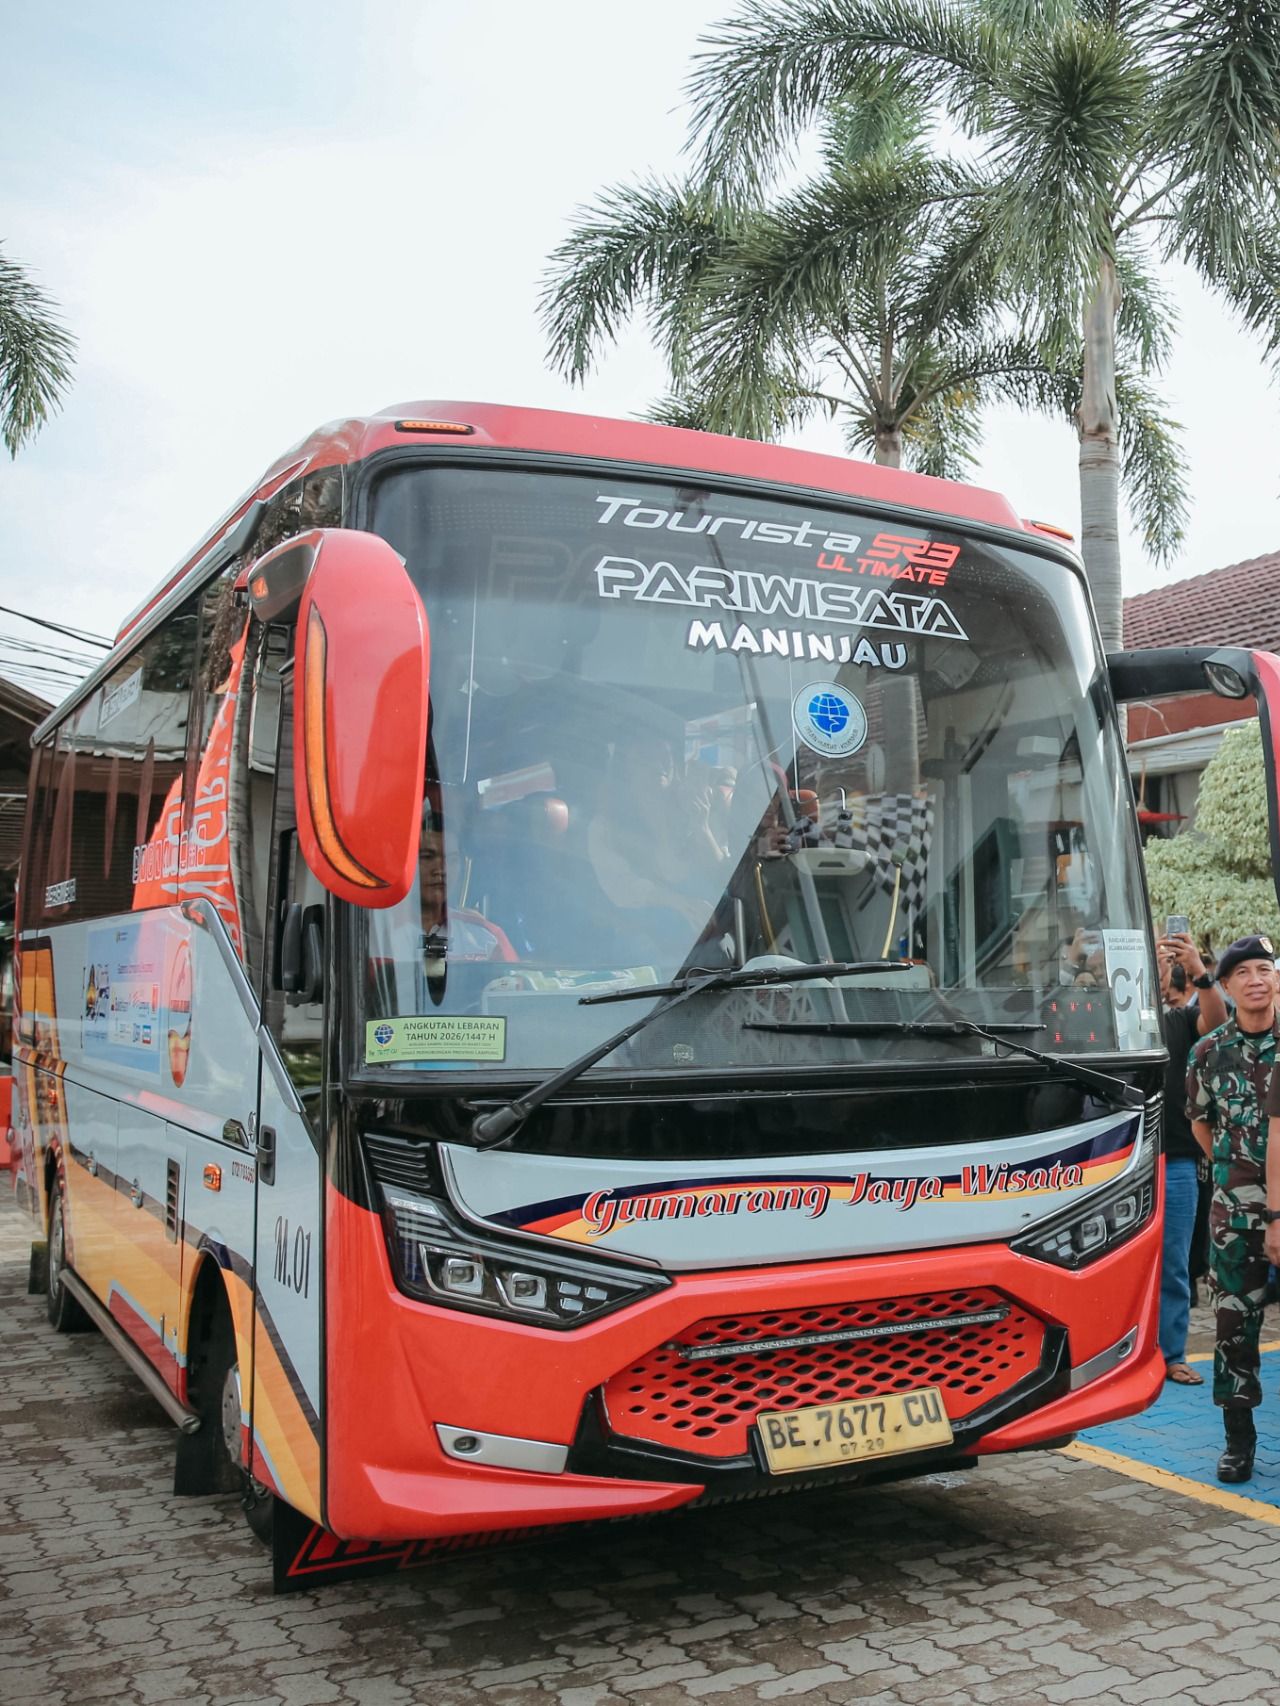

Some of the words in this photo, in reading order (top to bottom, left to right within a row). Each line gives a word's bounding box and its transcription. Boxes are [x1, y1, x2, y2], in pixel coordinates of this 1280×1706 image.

[595, 494, 862, 555] Tourista
[816, 550, 949, 587] ULTIMATE
[593, 554, 970, 641] PARIWISATA
[685, 618, 909, 670] MANINJAU
[1111, 967, 1144, 1012] C1
[403, 1022, 455, 1030] ANGKUTAN
[457, 1022, 500, 1030] LEBARAN
[405, 1032, 438, 1041] TAHUN
[440, 1032, 486, 1041] 2026/1447
[489, 1033, 496, 1041] H
[581, 1181, 830, 1238] Gumarang
[842, 1172, 944, 1217] Jaya
[960, 1158, 1084, 1198] Wisata
